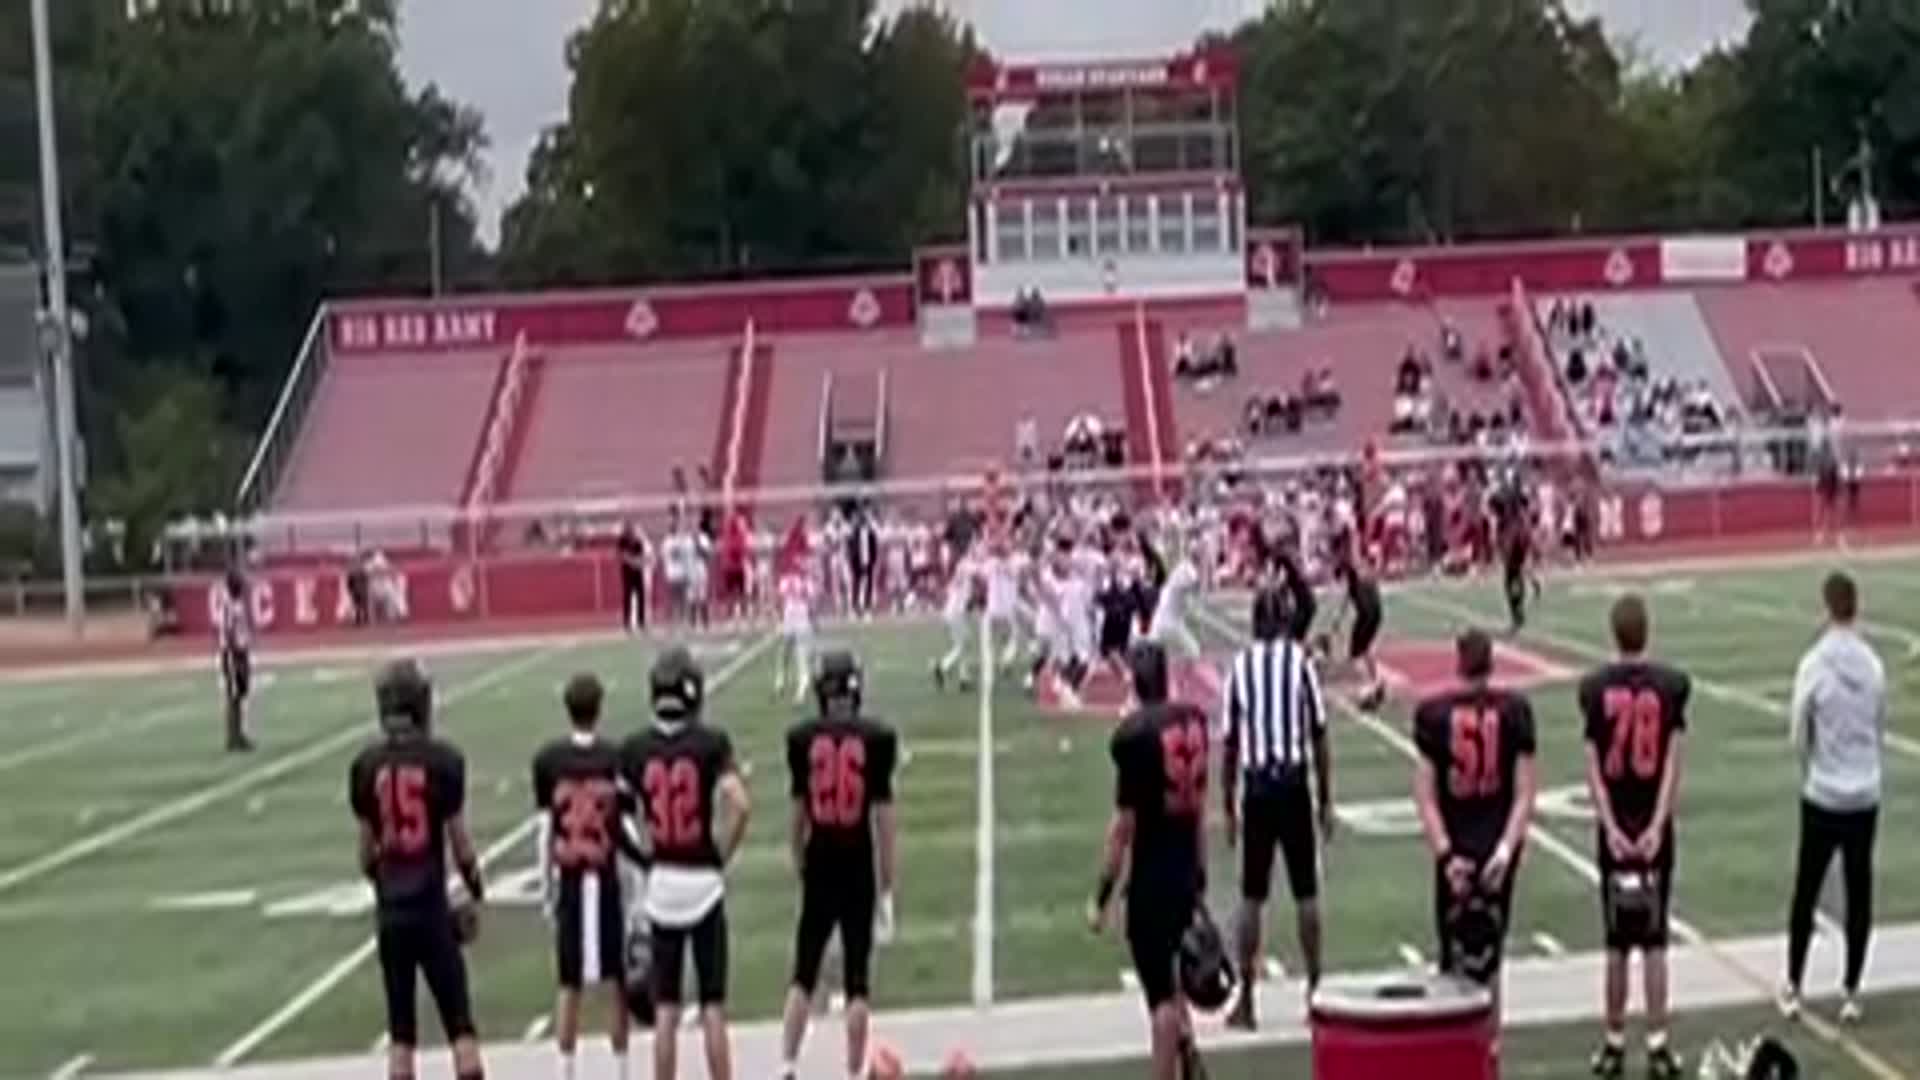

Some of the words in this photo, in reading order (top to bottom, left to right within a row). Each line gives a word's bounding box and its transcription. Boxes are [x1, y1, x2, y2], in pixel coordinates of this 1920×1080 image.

[433, 309, 496, 343] ARMY
[1449, 703, 1499, 798] 51
[1603, 686, 1661, 778] 78
[374, 762, 429, 854] 15
[643, 757, 701, 845] 32
[808, 733, 866, 827] 26
